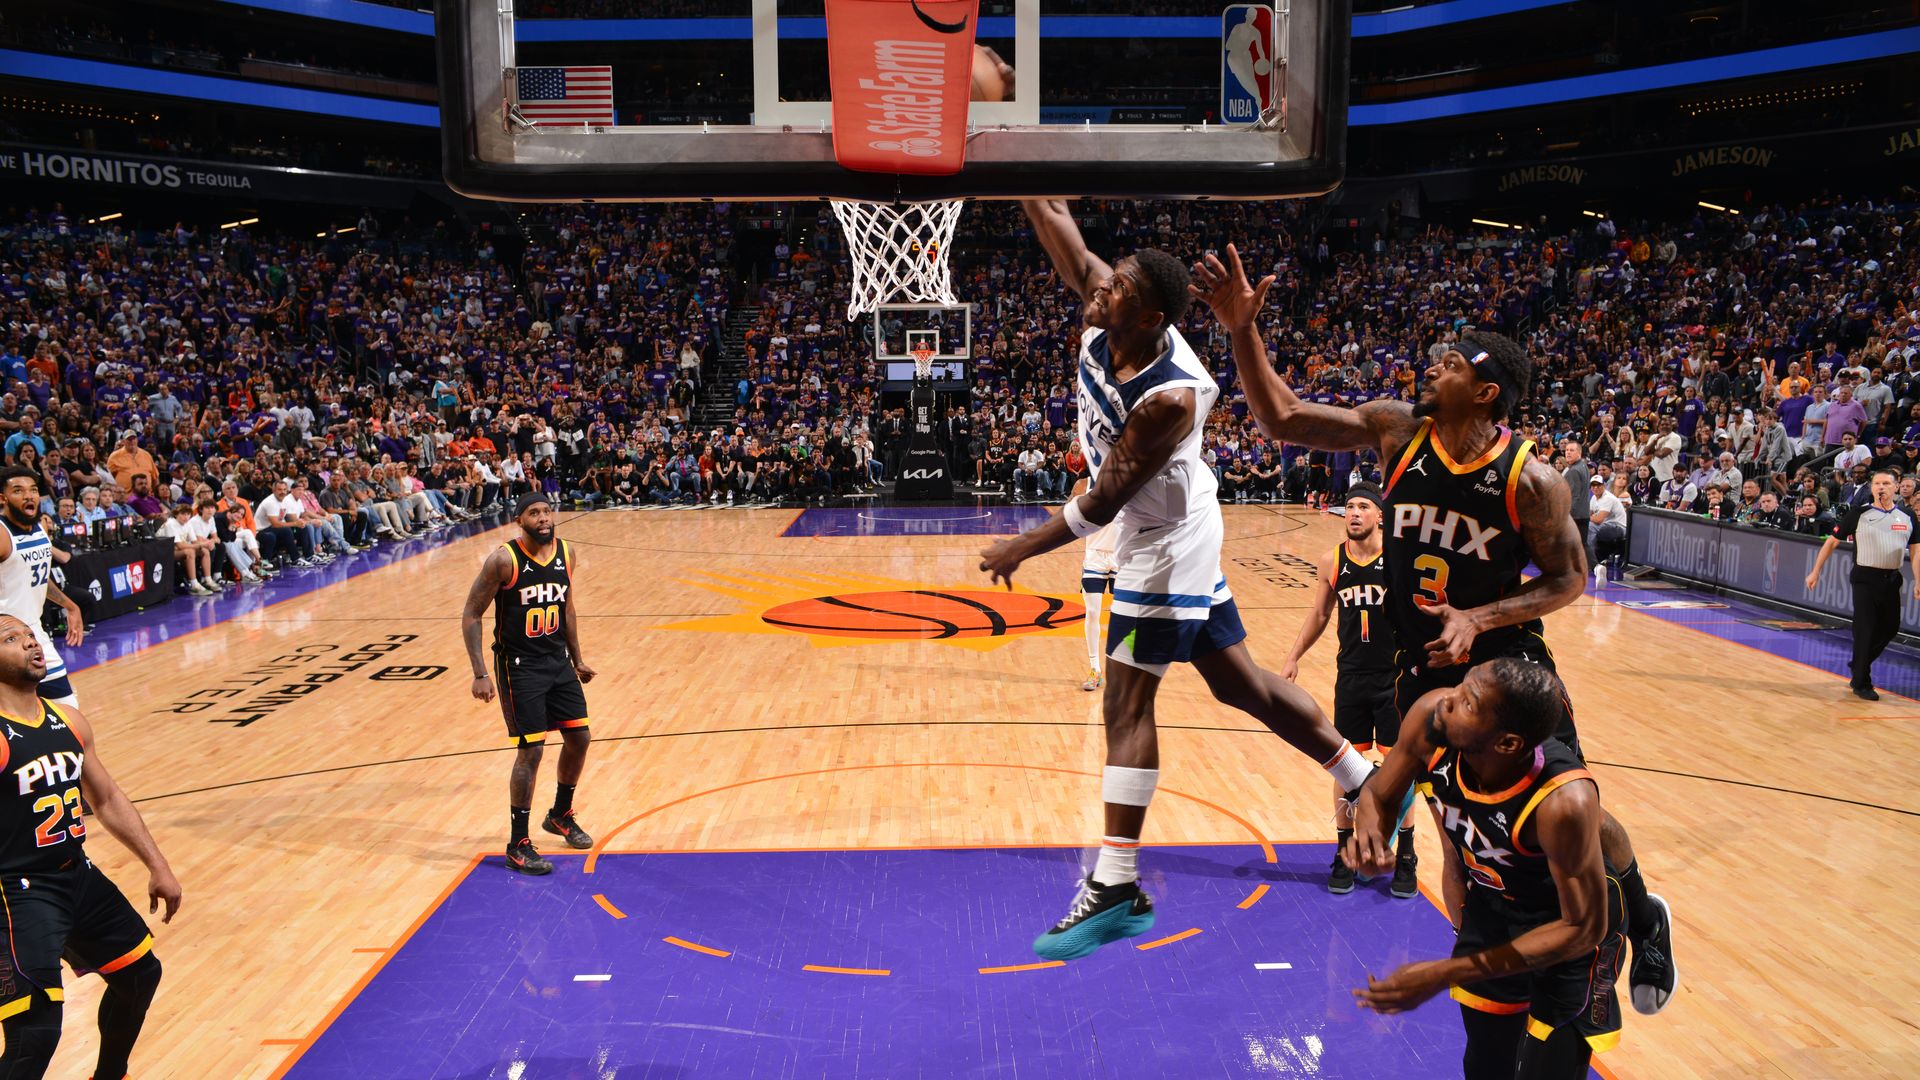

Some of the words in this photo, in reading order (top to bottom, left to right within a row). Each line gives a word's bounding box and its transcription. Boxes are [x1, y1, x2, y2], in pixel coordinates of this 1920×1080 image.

[1229, 98, 1253, 118] NBA
[22, 151, 182, 188] HORNITOS
[186, 171, 252, 189] TEQUILA
[1671, 145, 1774, 177] JAMESON
[1497, 164, 1585, 193] JAMESON
[917, 406, 928, 414] GET
[918, 415, 928, 423] THE
[1473, 483, 1502, 497] PayPal
[1393, 503, 1503, 561] PHX
[1647, 519, 1741, 584] NBAStore.com
[31, 561, 48, 587] 32
[1232, 557, 1310, 589] CENTER
[1413, 553, 1450, 608] 3
[519, 582, 568, 606] PHX
[526, 604, 559, 638] 00
[1360, 609, 1370, 643] 1
[151, 643, 340, 714] CENTER
[208, 634, 420, 728] FOOTPRINT
[13, 751, 84, 796] PHX
[33, 786, 86, 848] 23
[1460, 845, 1506, 891] 5
